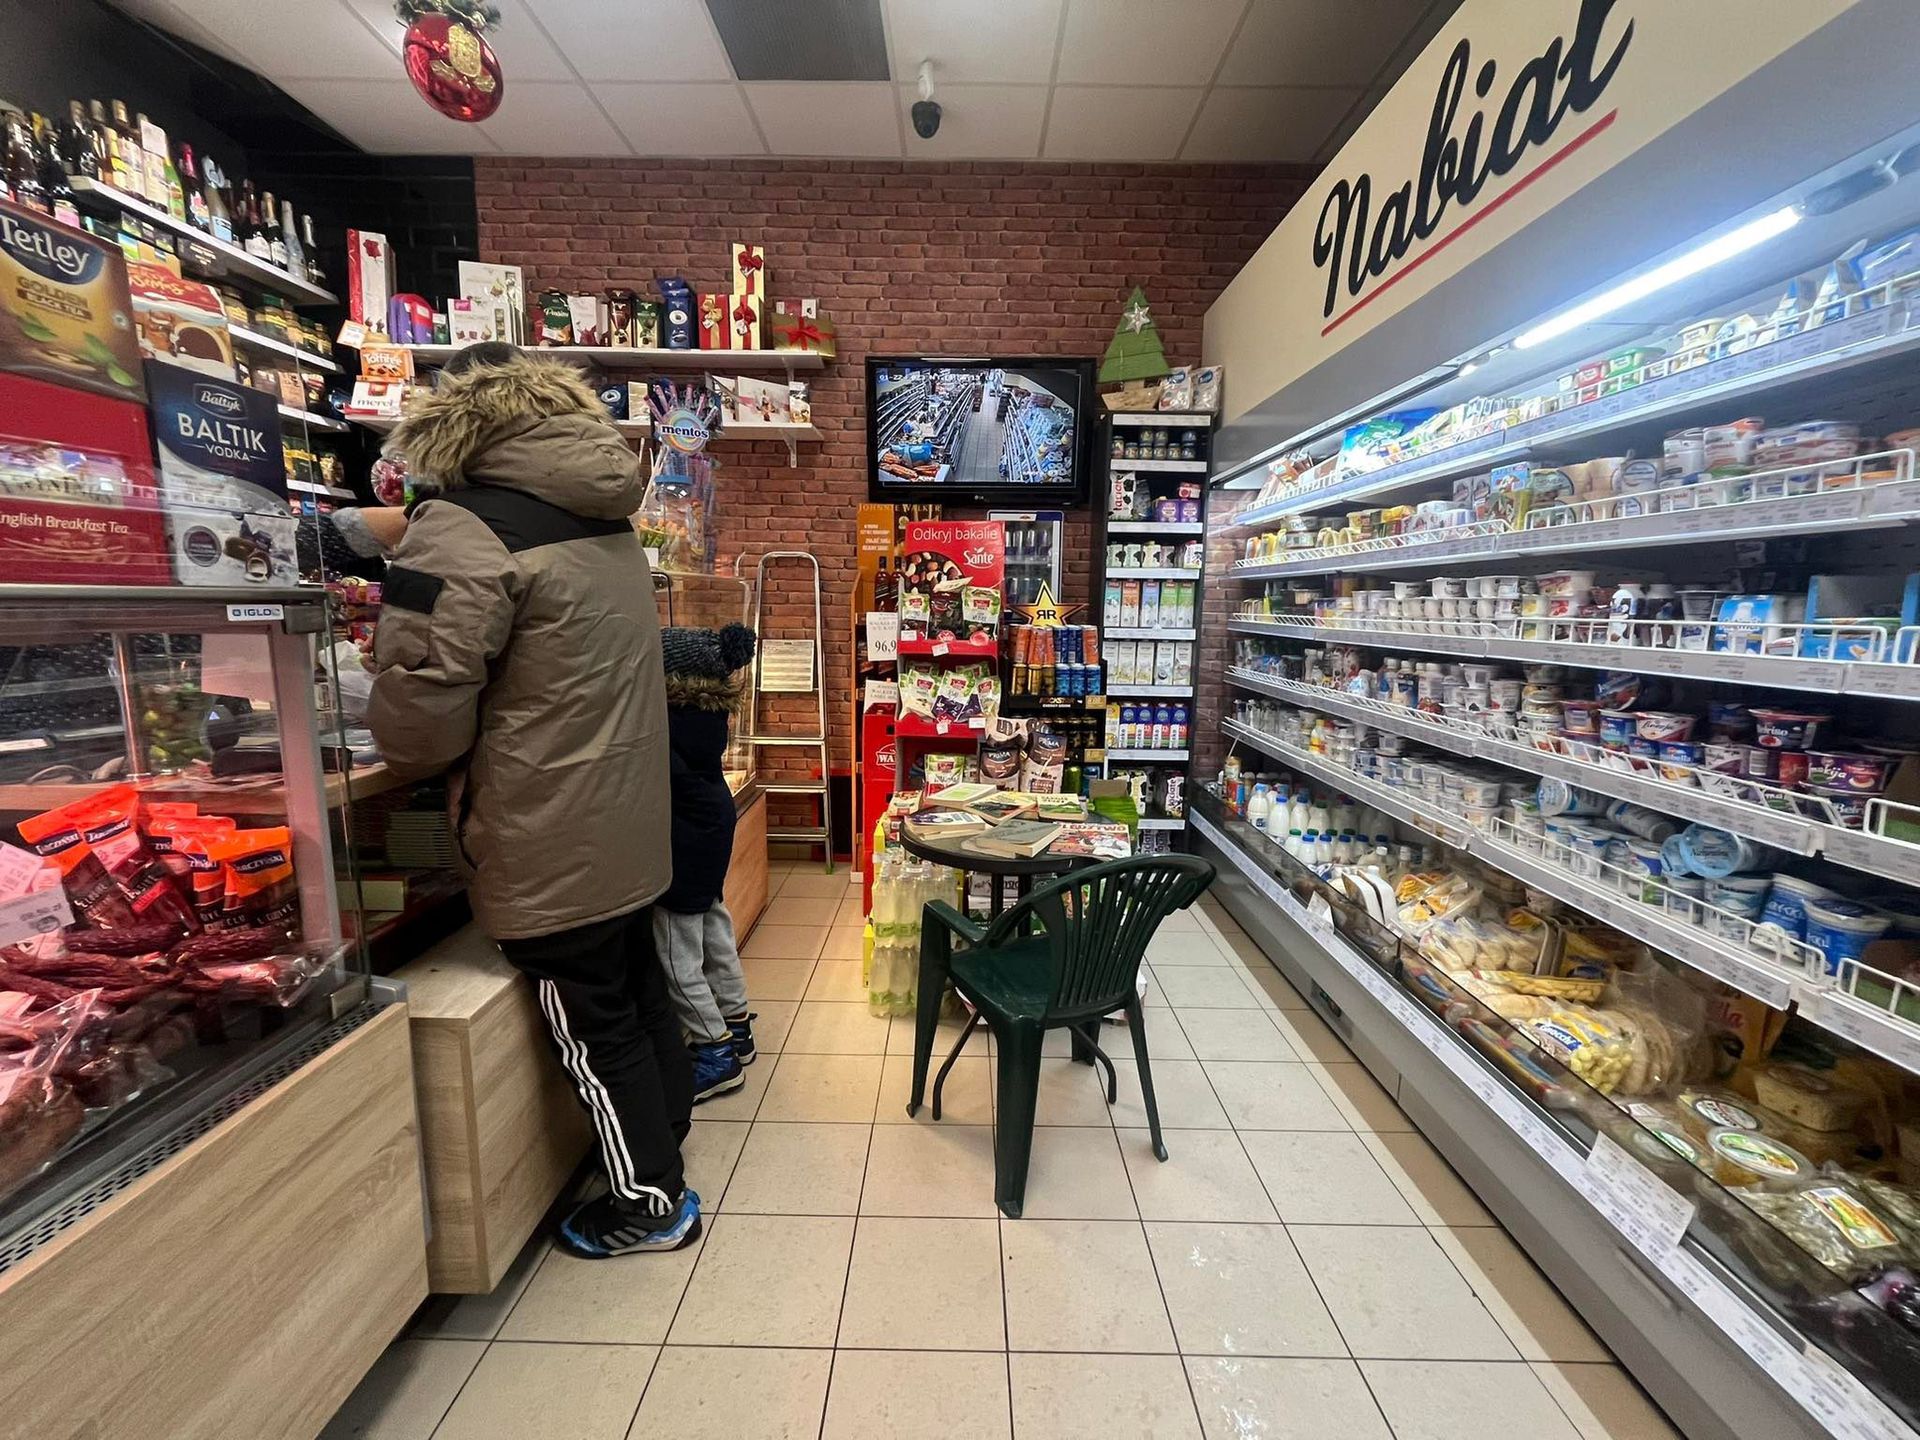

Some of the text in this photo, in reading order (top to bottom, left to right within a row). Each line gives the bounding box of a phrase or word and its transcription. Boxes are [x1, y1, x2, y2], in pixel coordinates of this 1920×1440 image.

[0, 214, 89, 275] Tetley
[177, 413, 266, 453] BALTIK
[661, 424, 709, 439] mentos
[205, 443, 250, 462] VODKA
[0, 512, 128, 534] nglish Breakfast Tea
[912, 526, 999, 543] Odkryj bakalie
[963, 551, 995, 566] Sante
